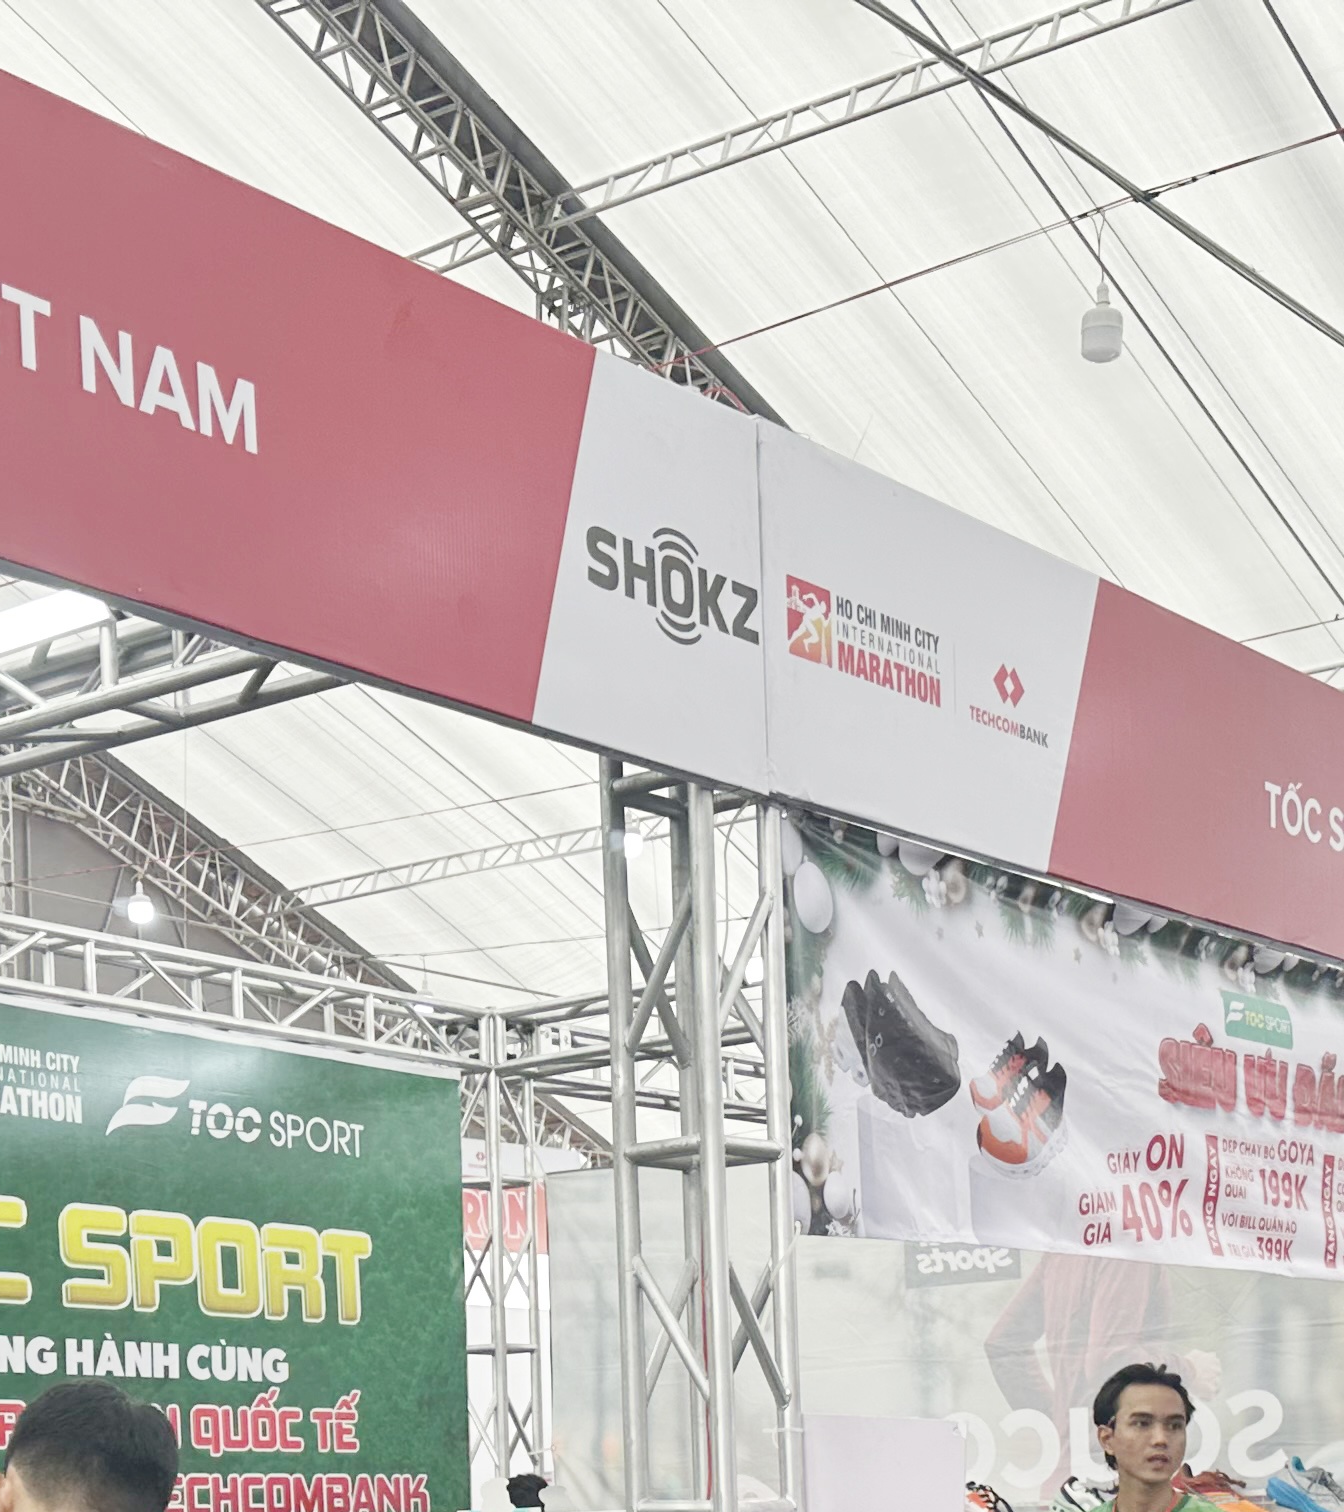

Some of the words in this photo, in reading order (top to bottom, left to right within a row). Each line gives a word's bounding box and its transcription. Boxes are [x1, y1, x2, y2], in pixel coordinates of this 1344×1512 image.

[79, 314, 258, 454] NAM
[586, 526, 759, 646] SHOKZ
[835, 595, 853, 620] HO
[856, 604, 877, 630] CHI
[880, 612, 911, 644] MINH
[914, 627, 940, 655] CITY
[836, 620, 941, 675] INTERNATIONAL
[837, 640, 942, 708] MARATHON
[969, 705, 1049, 748] TECHCOMBANK
[1264, 781, 1322, 843] TỐC
[45, 1047, 80, 1074] CITY
[189, 1099, 262, 1143] TOC
[269, 1115, 365, 1158] SPORT
[1146, 1133, 1184, 1171] ON
[1277, 1139, 1314, 1166] GOYA
[1122, 1178, 1193, 1242] 40%
[1259, 1168, 1309, 1211] 199K
[1239, 1215, 1256, 1230] BILL
[1257, 1237, 1293, 1263] 399K
[58, 1202, 372, 1325] SPORT
[65, 1331, 180, 1380] HÀNH
[187, 1340, 291, 1384] CÙNG
[191, 1389, 304, 1456] QUỐC
[310, 1389, 362, 1453] TẾ
